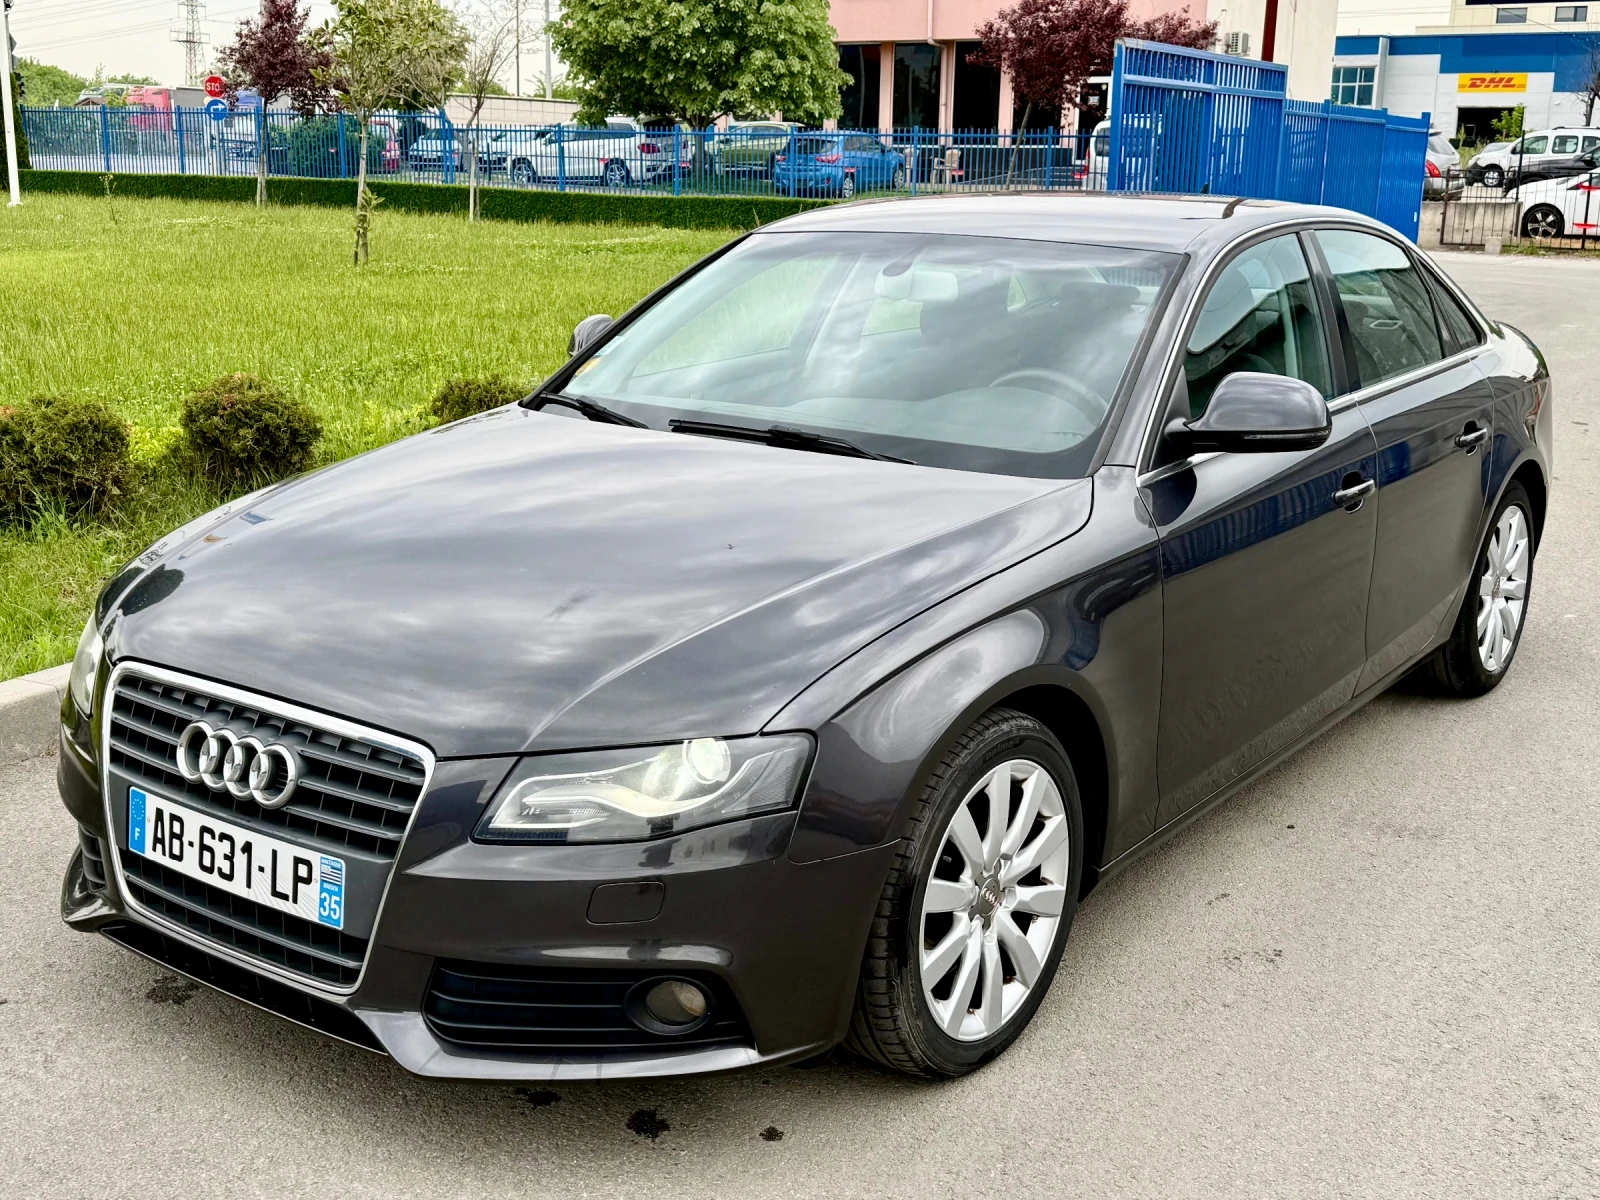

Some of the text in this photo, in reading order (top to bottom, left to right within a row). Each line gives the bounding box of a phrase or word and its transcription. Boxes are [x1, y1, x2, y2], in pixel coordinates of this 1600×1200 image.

[206, 82, 225, 91] STO
[1468, 77, 1516, 88] DHL
[134, 827, 140, 840] F
[152, 807, 313, 905] AB-631-LP
[320, 892, 340, 920] 35
